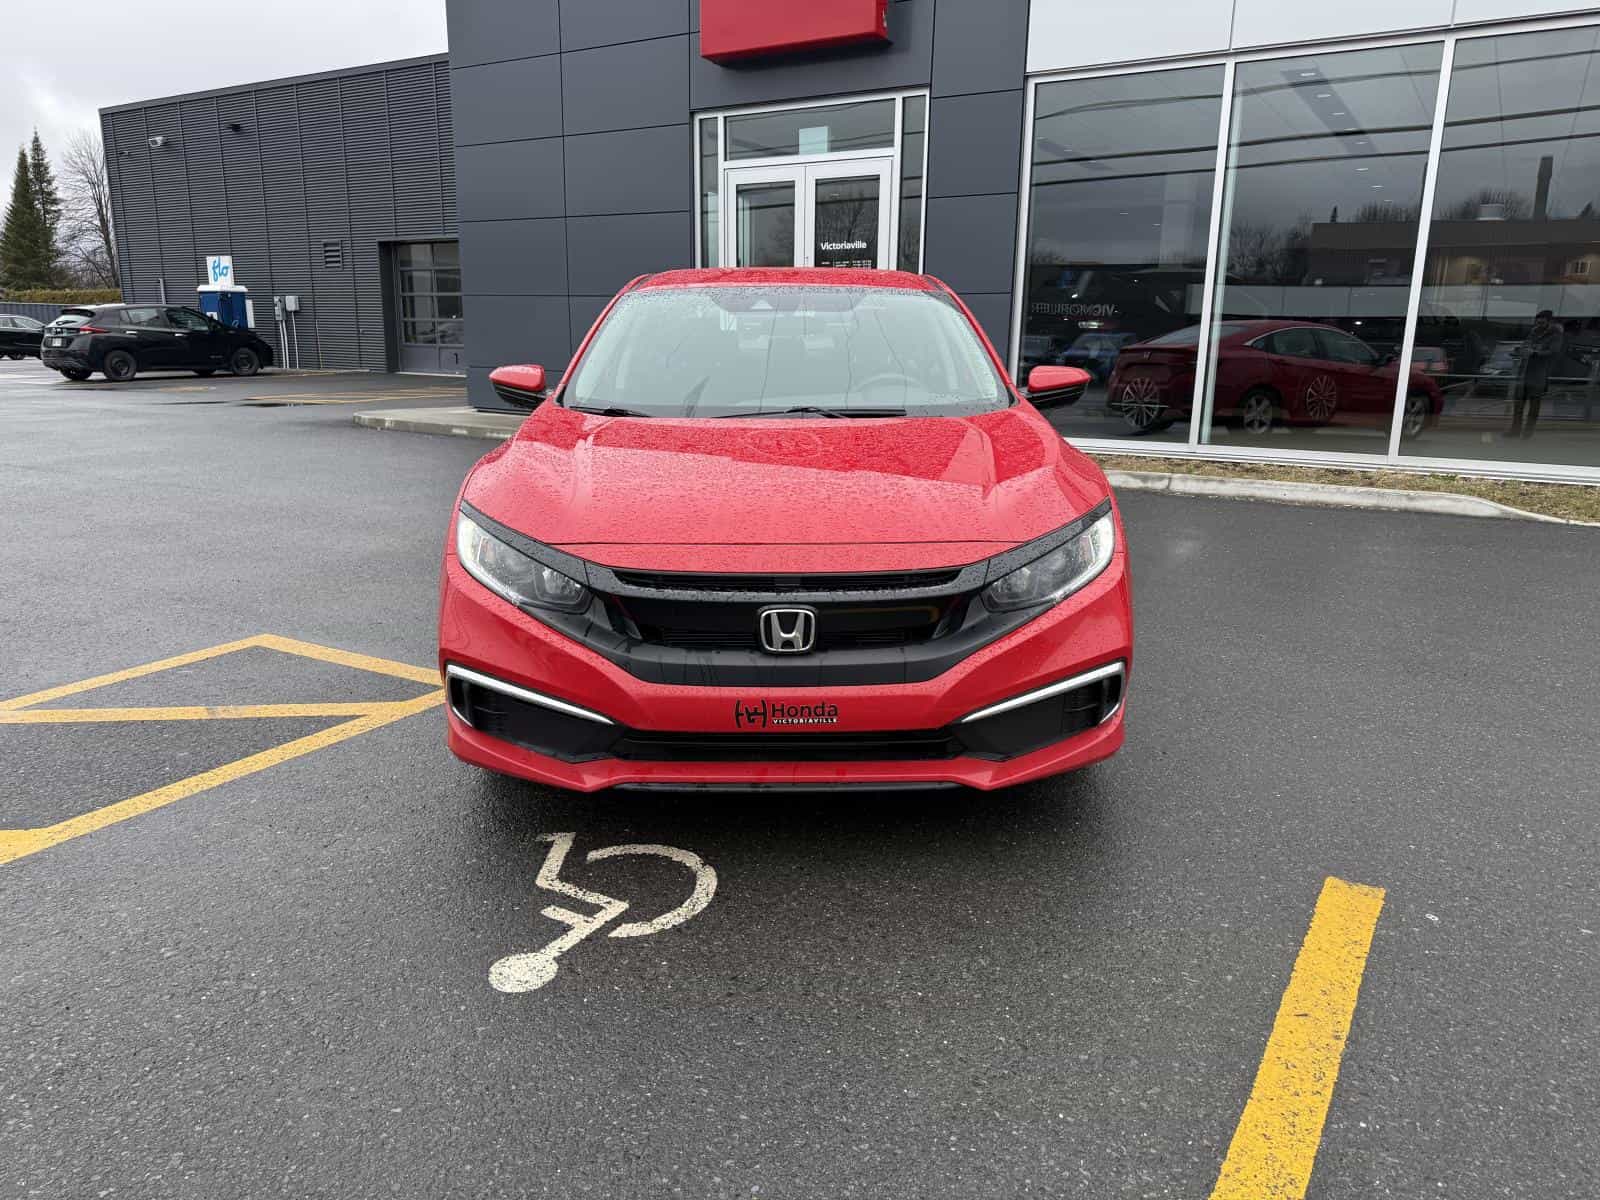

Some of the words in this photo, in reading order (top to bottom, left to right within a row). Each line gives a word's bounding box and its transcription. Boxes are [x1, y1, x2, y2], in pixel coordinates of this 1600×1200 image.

[820, 240, 867, 250] Victoriaville
[211, 256, 230, 282] flo
[771, 702, 839, 717] Honda
[773, 717, 838, 725] VICTORIAVILLE
